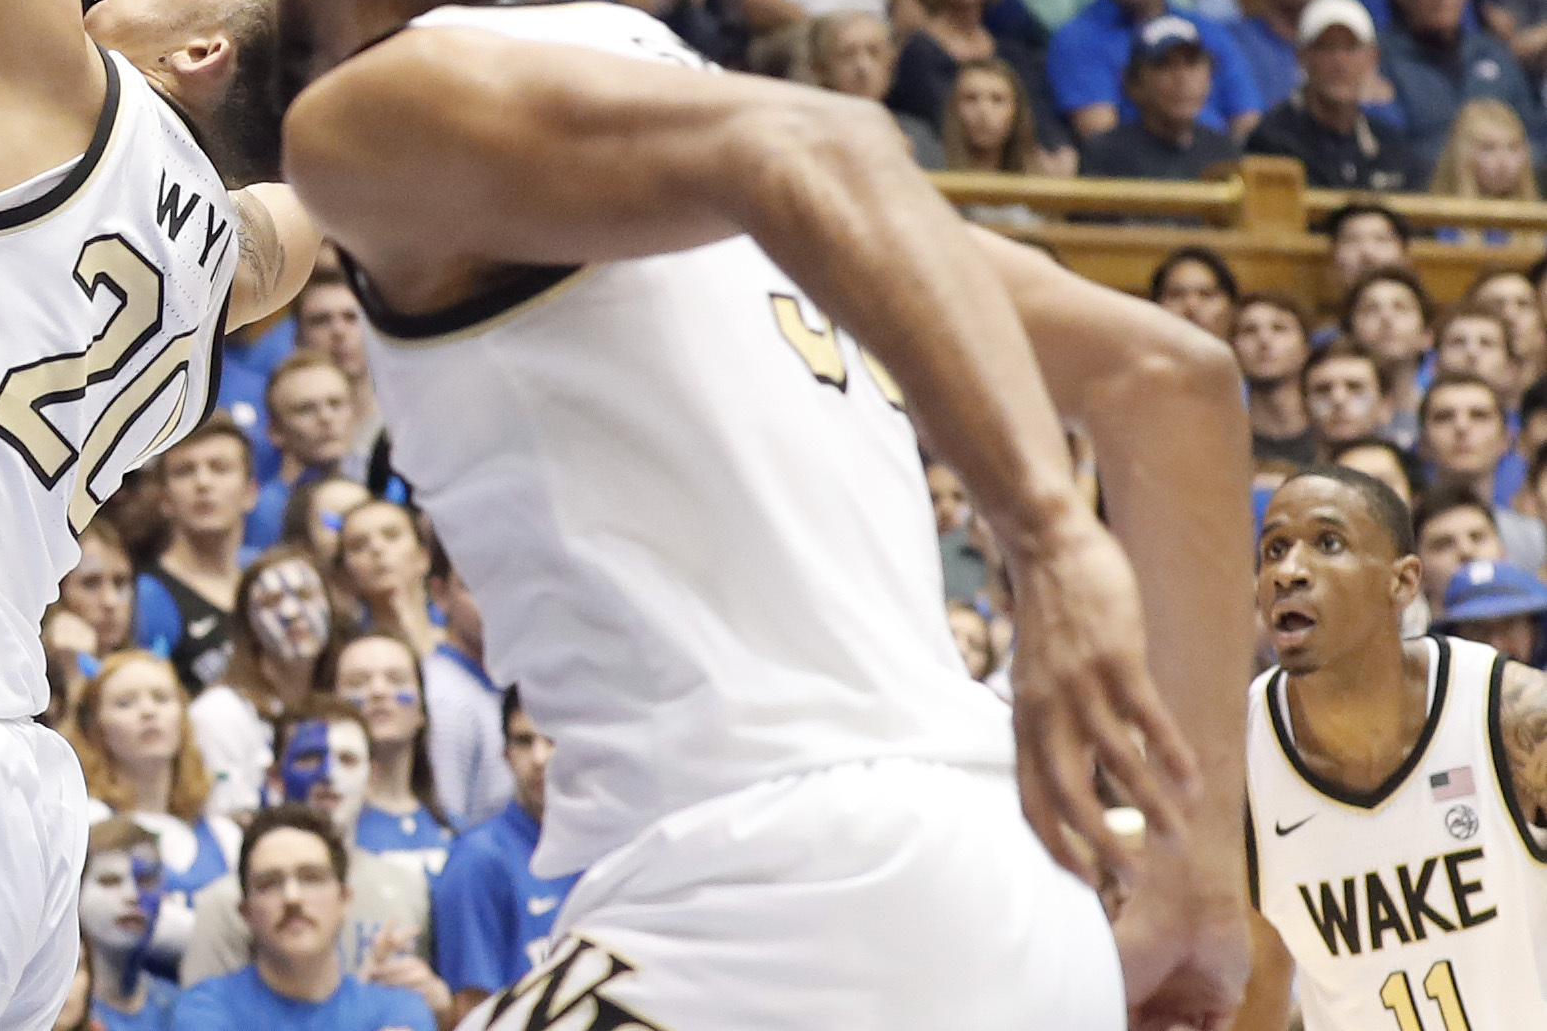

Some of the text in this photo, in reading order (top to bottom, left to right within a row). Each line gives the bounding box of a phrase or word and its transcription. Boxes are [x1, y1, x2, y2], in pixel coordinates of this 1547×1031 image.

[156, 167, 234, 283] WY
[1298, 847, 1498, 957] WAKE
[1379, 959, 1473, 1031] 11
